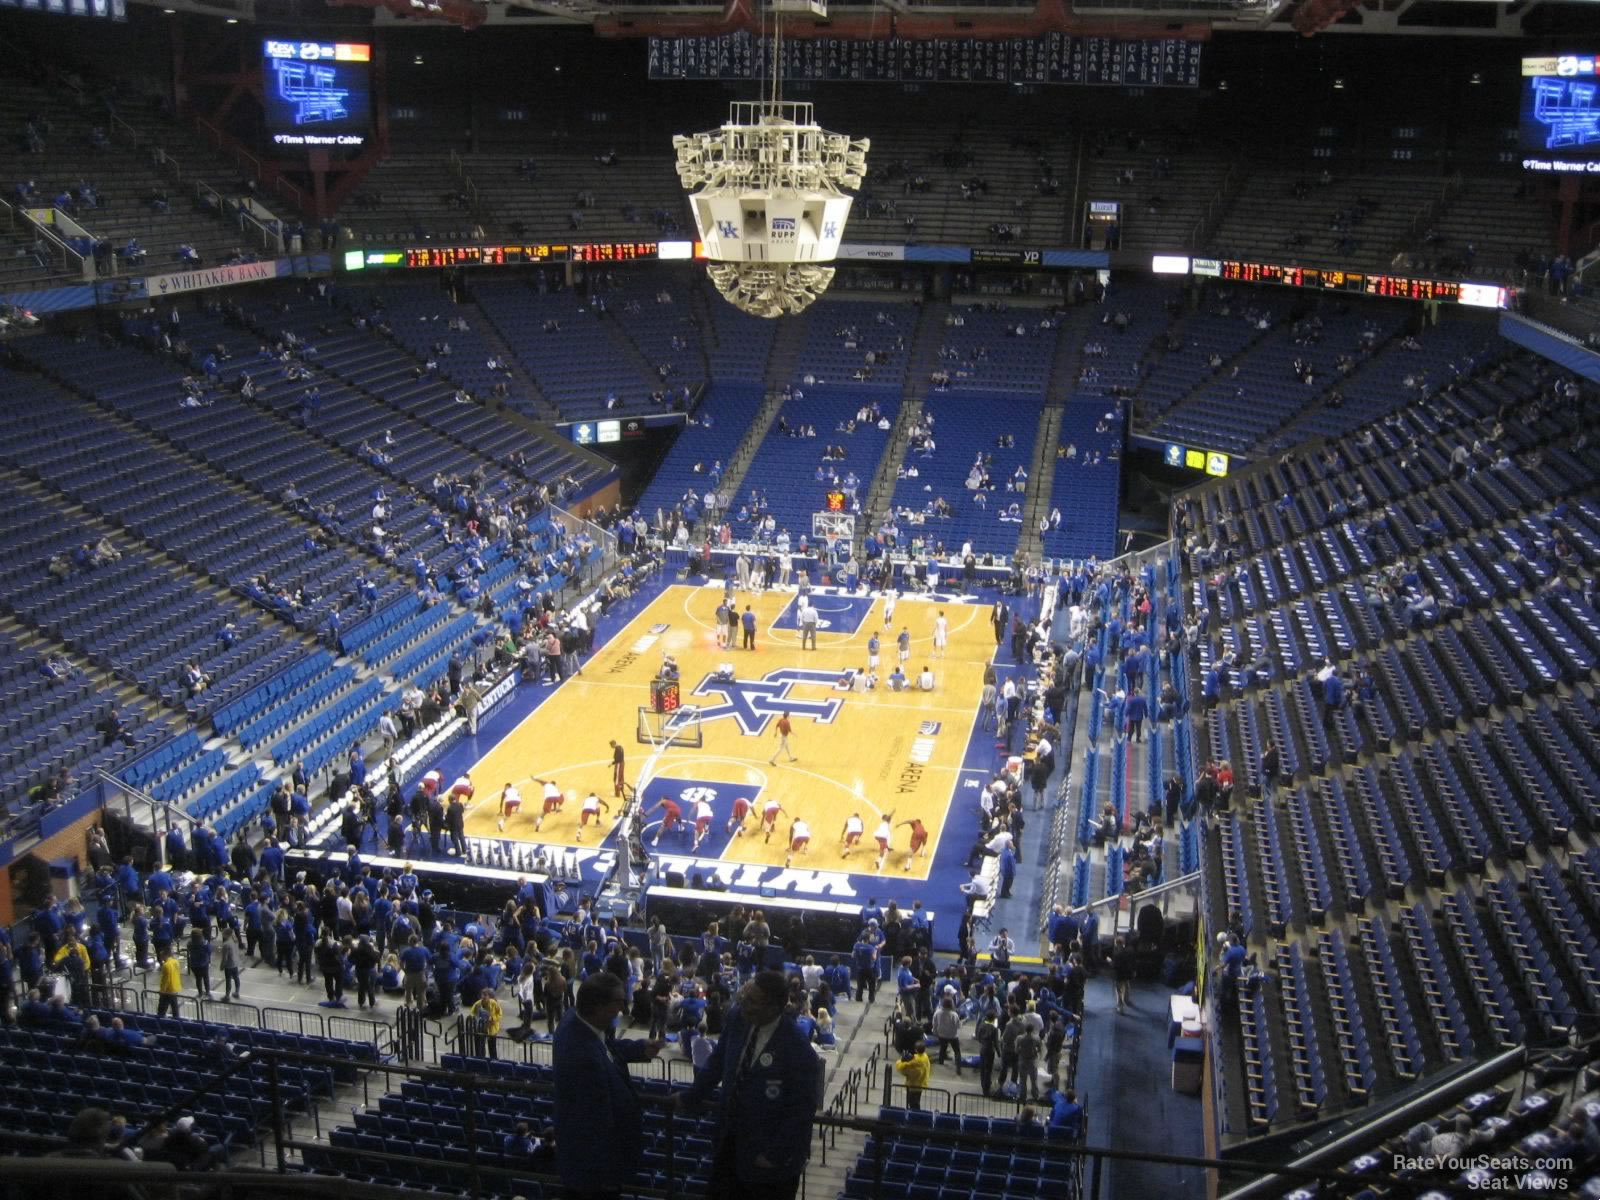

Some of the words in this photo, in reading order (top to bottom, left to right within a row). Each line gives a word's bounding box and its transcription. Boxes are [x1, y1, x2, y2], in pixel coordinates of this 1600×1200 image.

[281, 135, 304, 144] Time
[304, 135, 336, 144] Warner
[337, 135, 362, 144] Cable
[1530, 160, 1552, 170] Time
[1553, 161, 1585, 171] Warner
[716, 210, 740, 239] UK
[771, 231, 795, 239] RUPP
[1024, 250, 1039, 262] yp
[170, 269, 234, 289] WHITAKER
[240, 265, 268, 280] BANK
[664, 695, 677, 710] 35
[895, 761, 924, 794] ARENA
